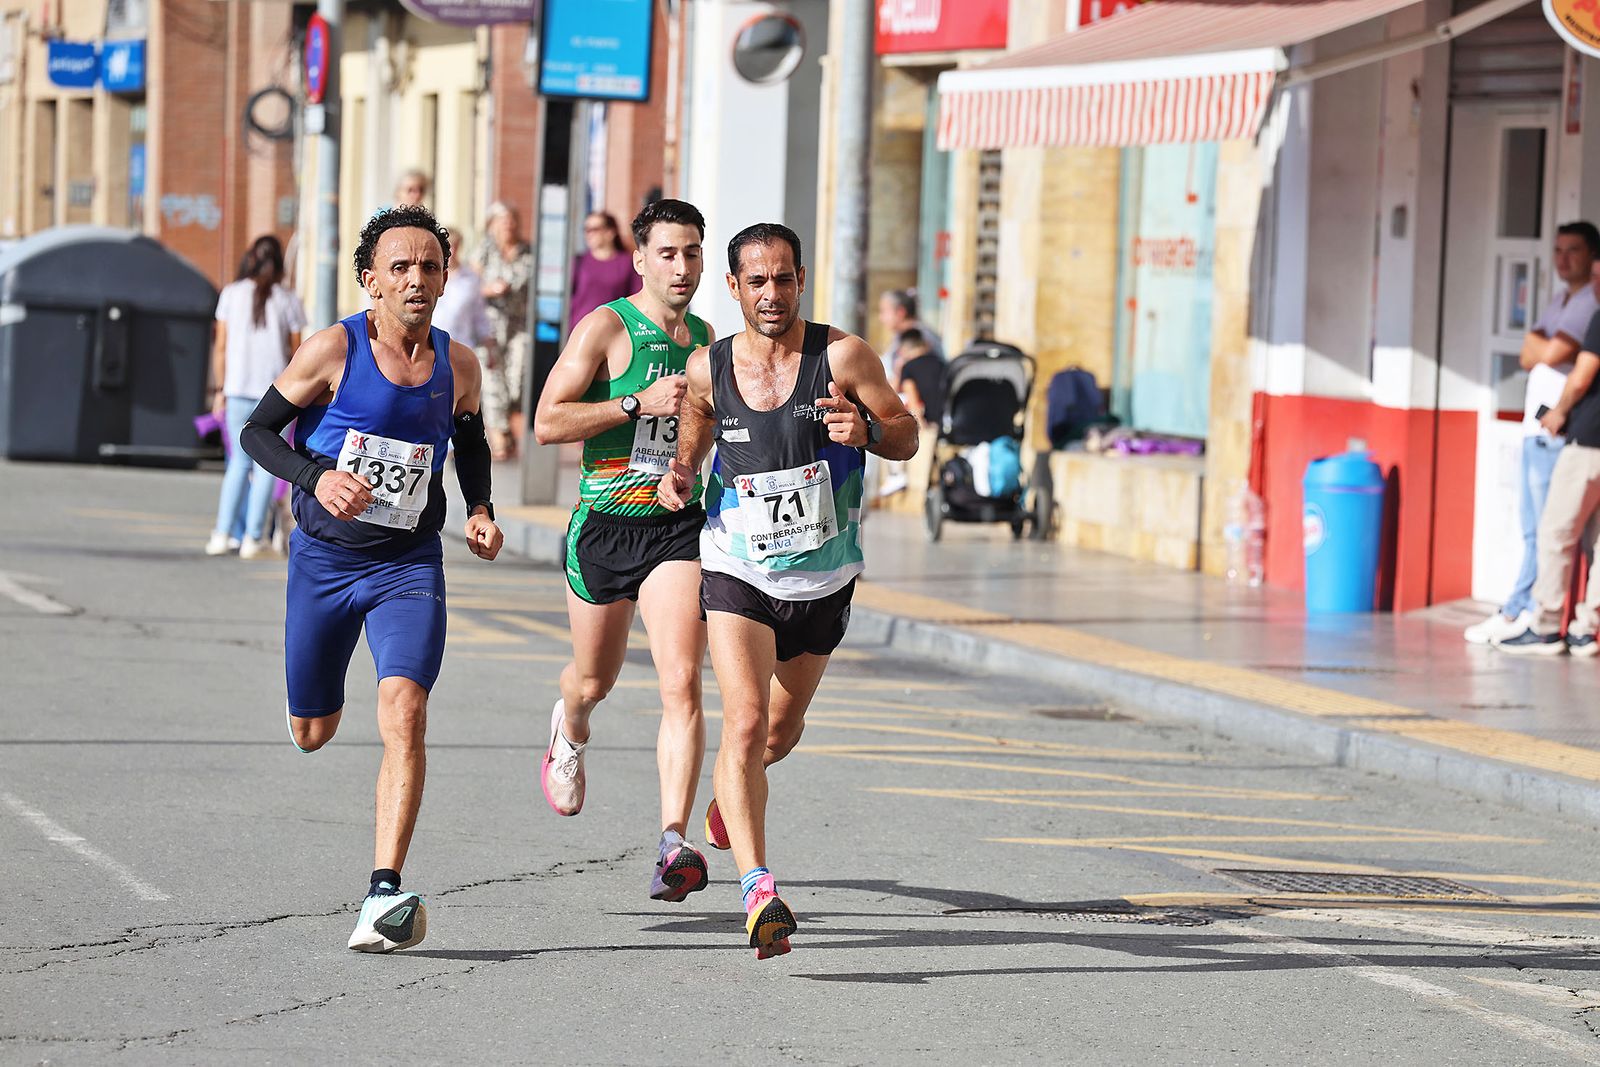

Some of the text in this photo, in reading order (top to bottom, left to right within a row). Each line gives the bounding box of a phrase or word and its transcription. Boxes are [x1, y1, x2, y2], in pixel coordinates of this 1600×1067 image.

[347, 456, 425, 496] 1337
[763, 490, 805, 524] 71
[751, 526, 803, 543] CONTRERAS
